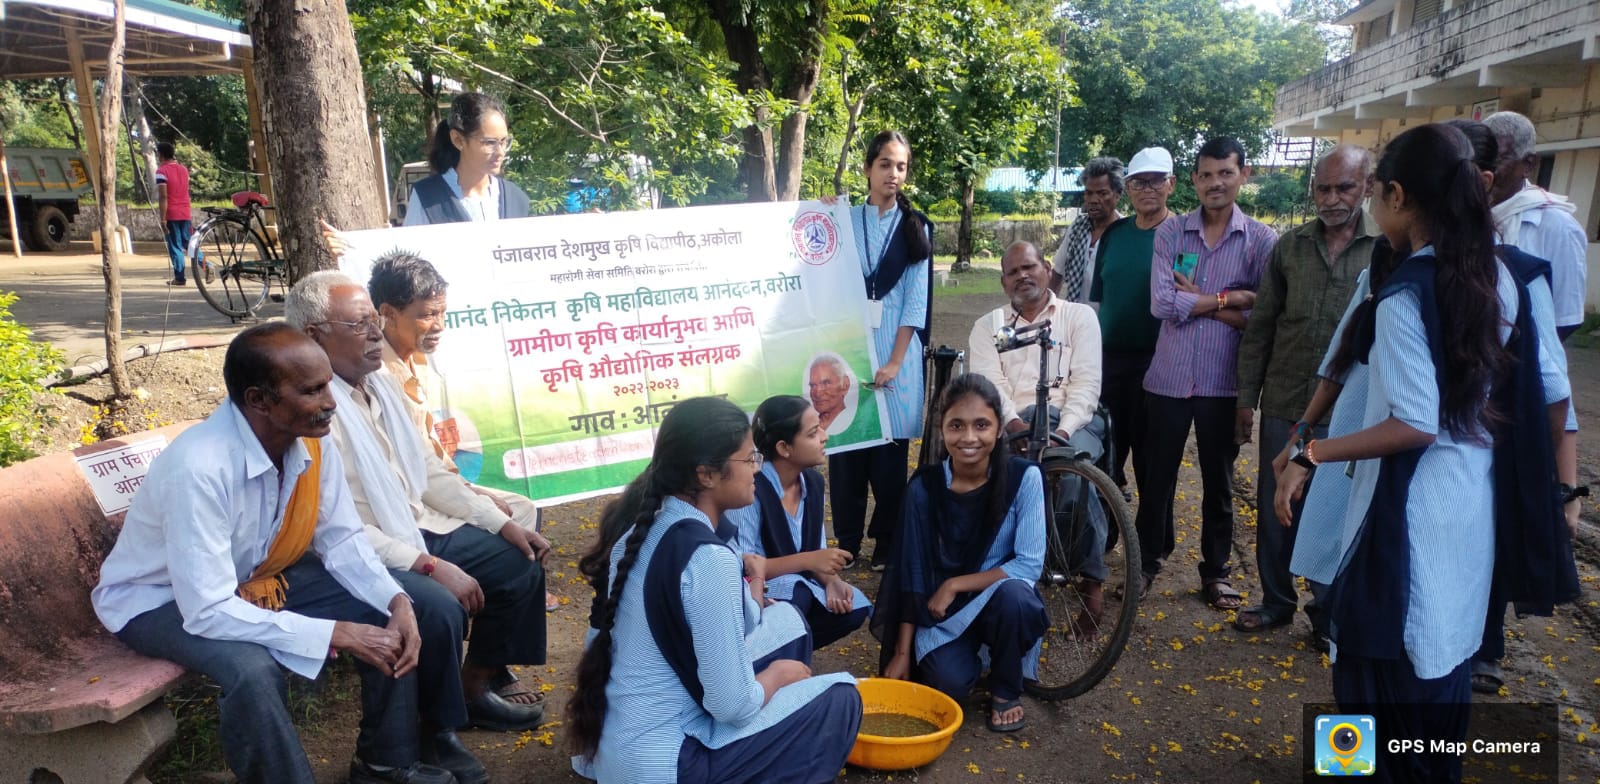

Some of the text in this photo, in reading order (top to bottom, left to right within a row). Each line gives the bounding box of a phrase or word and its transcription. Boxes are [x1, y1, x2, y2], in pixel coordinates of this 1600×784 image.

[493, 245, 557, 264] पंजाबराव
[561, 239, 611, 261] देशमुख
[614, 235, 642, 259] कृषि
[586, 267, 604, 280] सेवा
[491, 299, 556, 324] निकेतन
[565, 292, 601, 322] कृषि
[606, 287, 699, 312] महाविद्यालय
[508, 306, 755, 357] ग्रामीण कृषि कार्यानुभव आणि
[540, 360, 584, 392] कृषि
[589, 350, 674, 379] औद्योगिक
[568, 410, 615, 434] गाव
[88, 459, 120, 478] ग्राम
